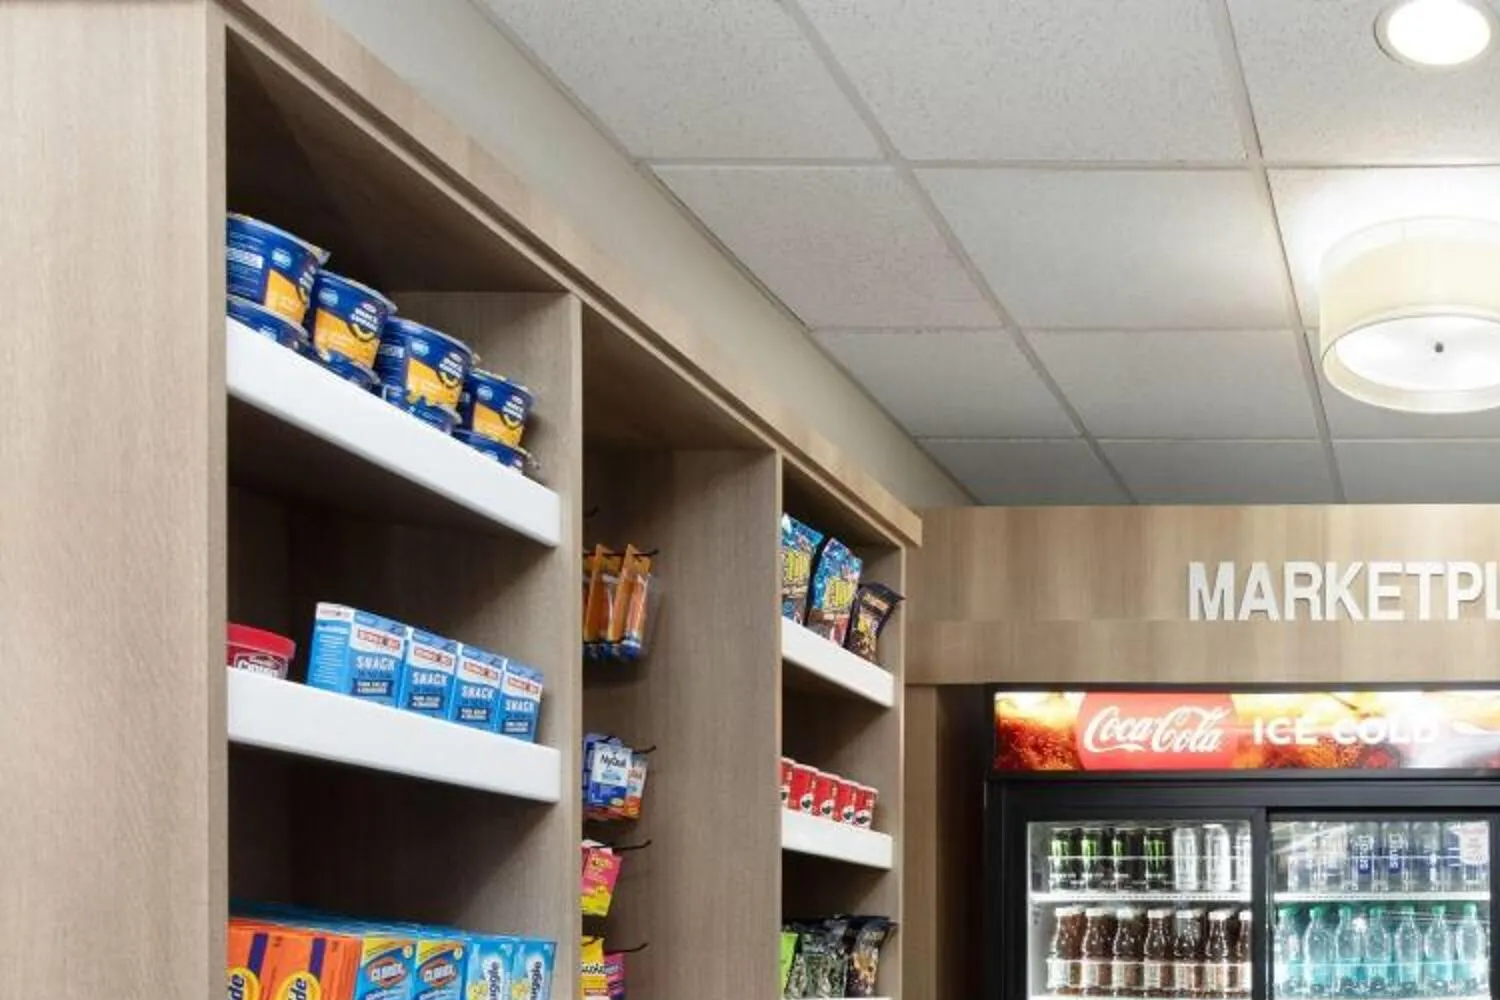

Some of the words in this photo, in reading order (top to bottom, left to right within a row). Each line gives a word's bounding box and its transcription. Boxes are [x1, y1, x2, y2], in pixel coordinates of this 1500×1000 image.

[356, 655, 396, 671] SNACK
[412, 671, 449, 687] SNACK
[461, 685, 495, 701] SNACK
[1083, 705, 1233, 753] Coca-Cola
[1252, 717, 1319, 745] ICE
[1333, 717, 1440, 746] COLD
